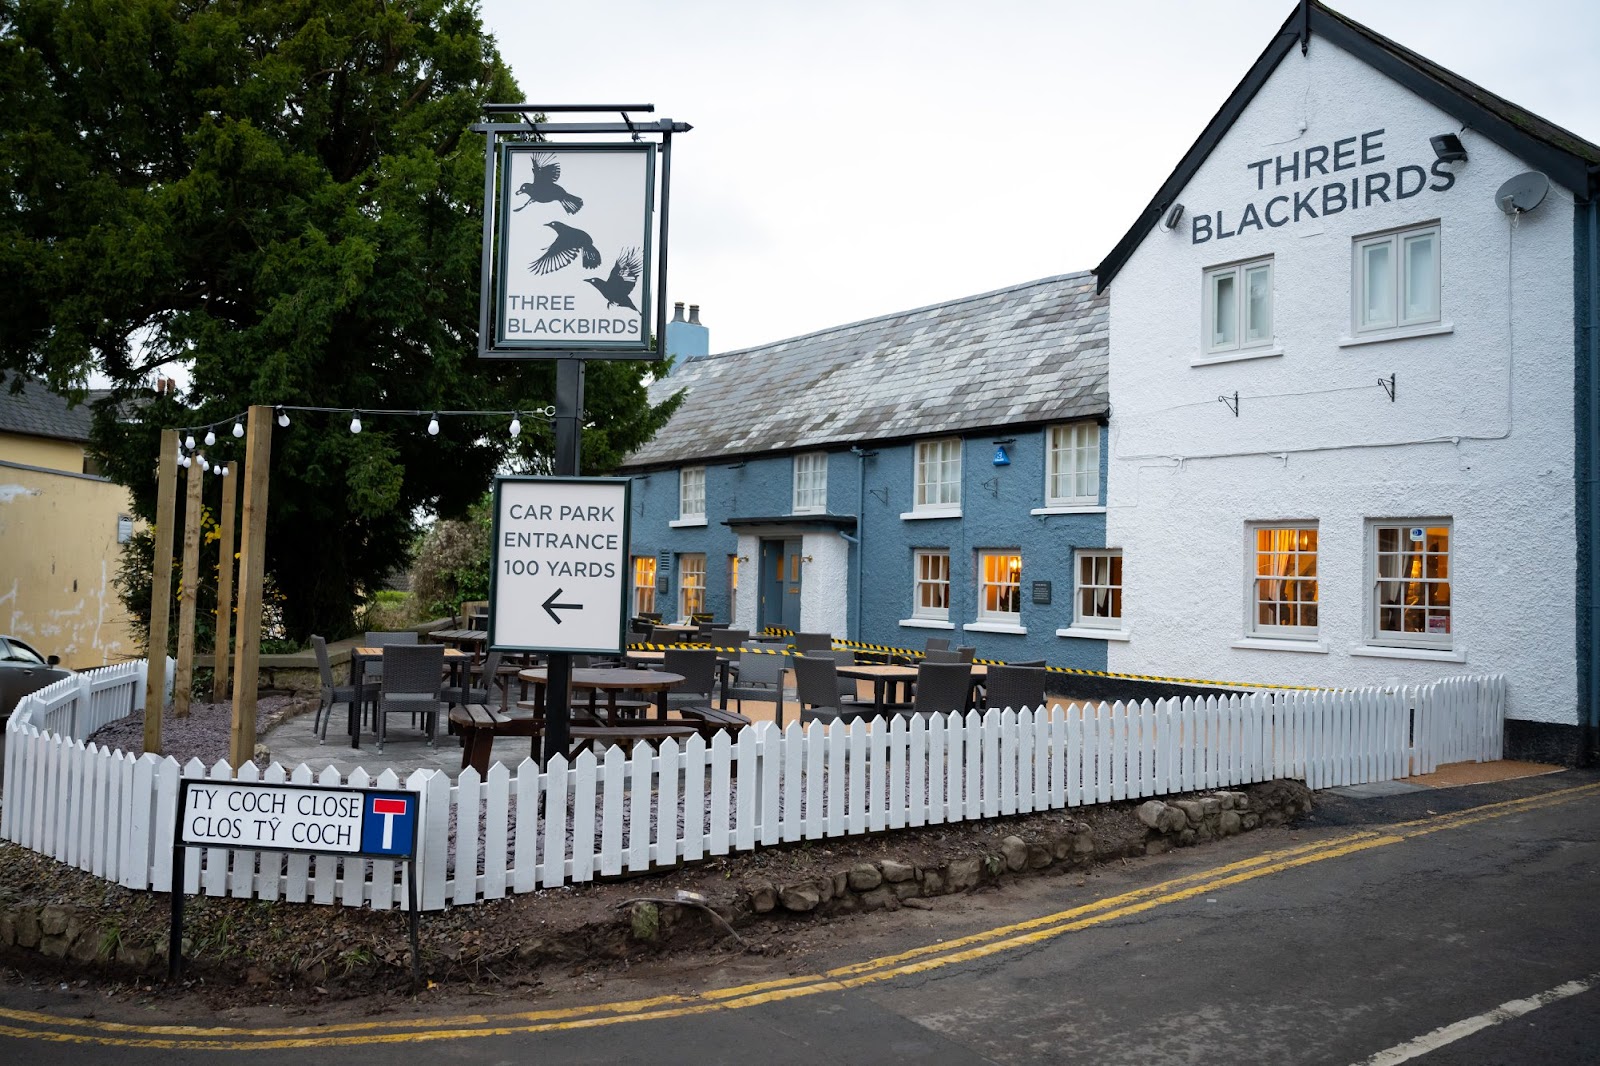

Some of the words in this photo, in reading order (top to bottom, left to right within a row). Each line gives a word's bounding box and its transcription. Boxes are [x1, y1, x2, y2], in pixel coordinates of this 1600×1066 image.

[1247, 128, 1385, 190] THREE
[1192, 158, 1455, 245] BLACKBIRDS
[508, 295, 575, 311] THREE
[508, 318, 639, 334] BLACKBIRDS
[509, 504, 553, 521] CAR
[560, 505, 615, 522] PARK
[504, 532, 618, 550] ENTRANCE
[504, 559, 539, 576] 100
[546, 560, 615, 578] YARDS
[190, 789, 218, 810] TY
[228, 791, 286, 814] COCH
[297, 794, 360, 818] CLOSE
[192, 816, 242, 839] CLOS
[253, 817, 282, 841] TŶ
[292, 822, 352, 846] COCH
